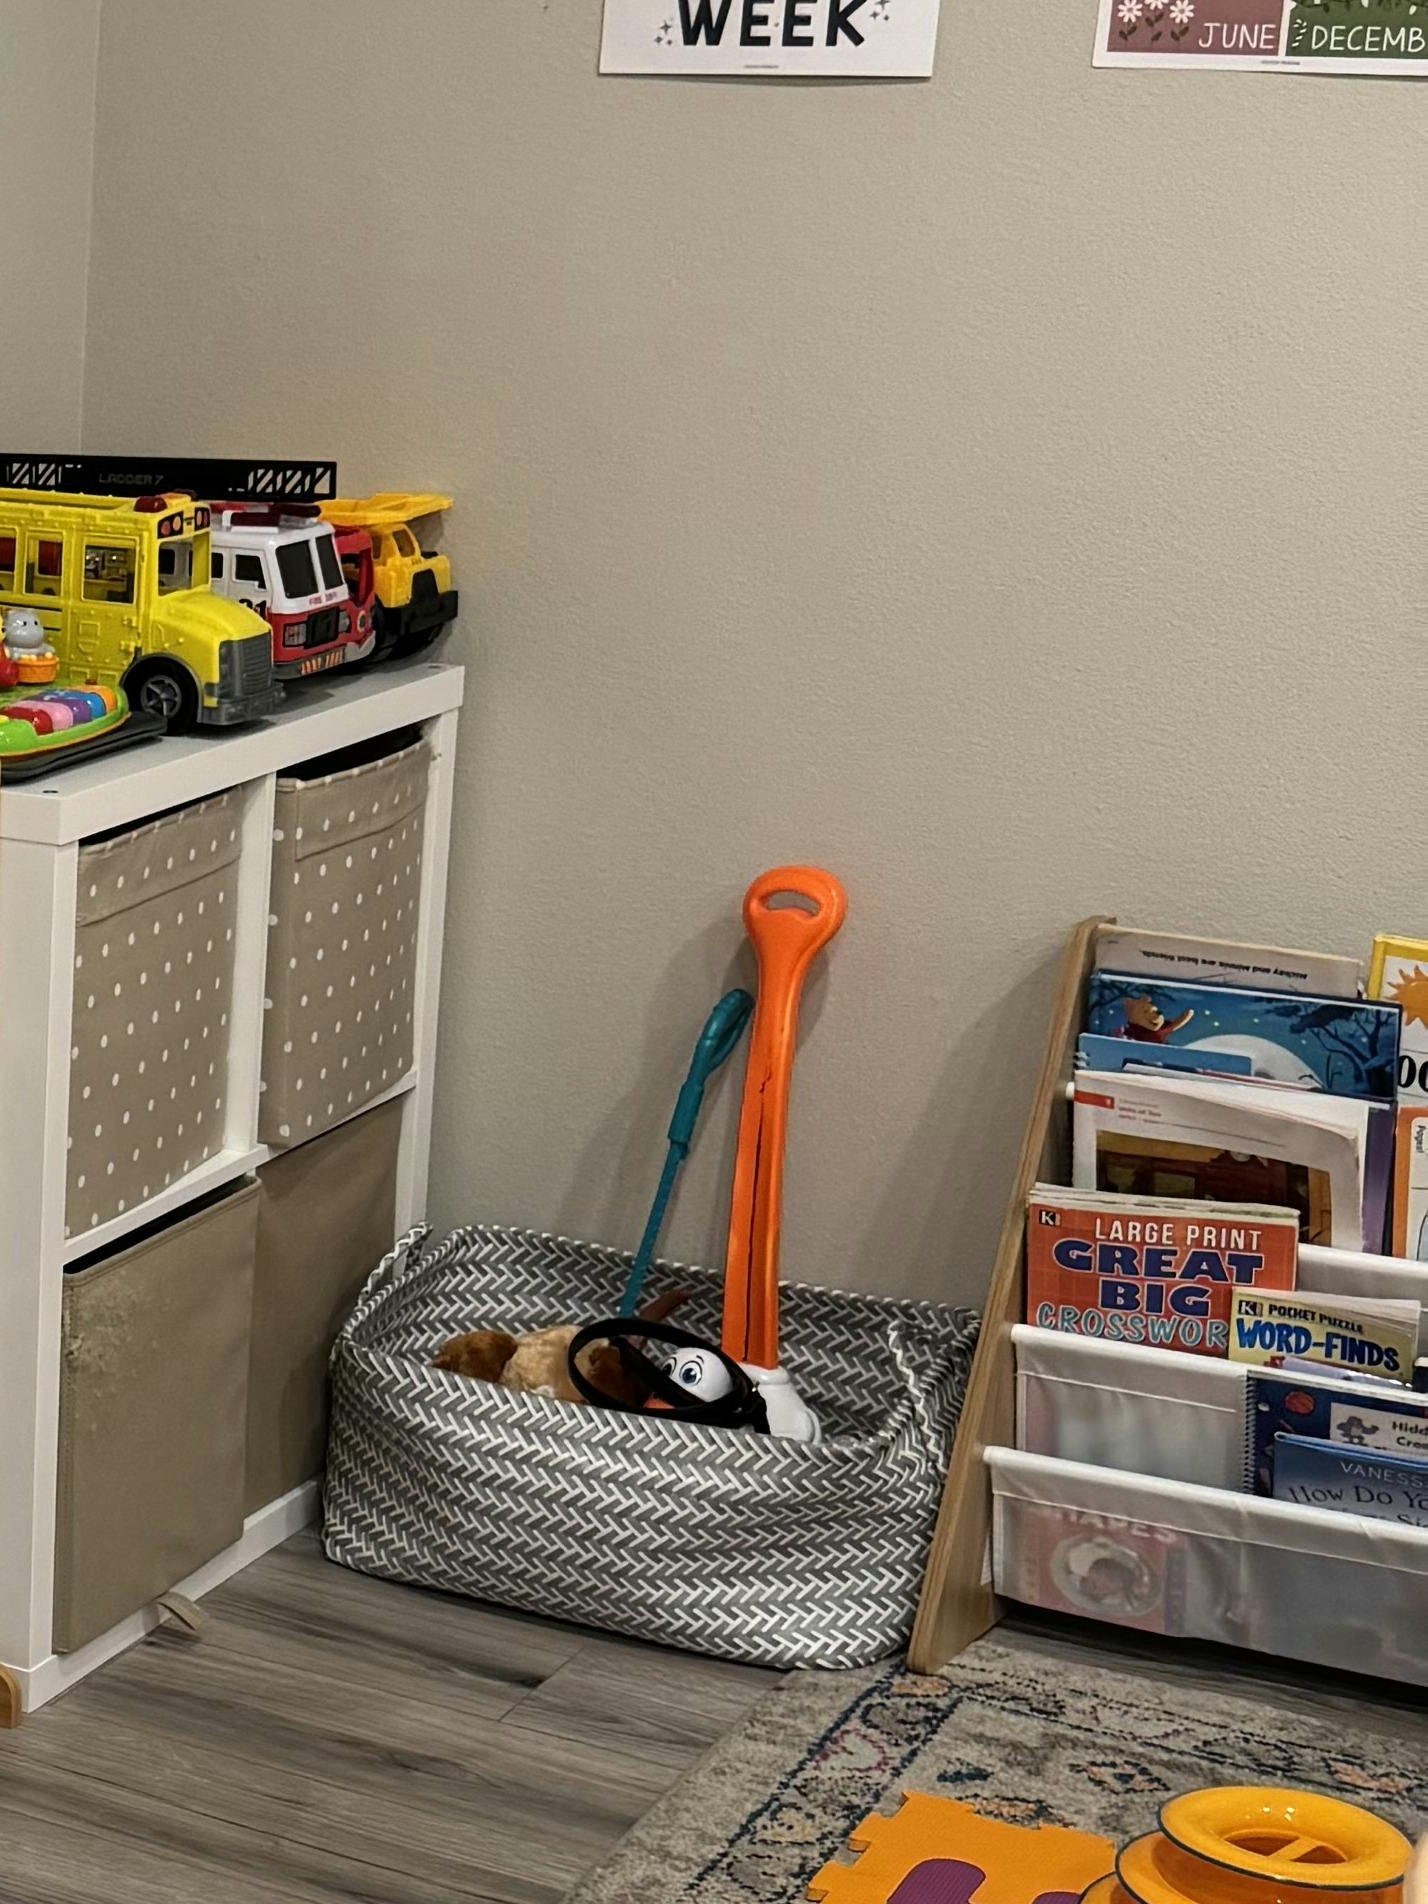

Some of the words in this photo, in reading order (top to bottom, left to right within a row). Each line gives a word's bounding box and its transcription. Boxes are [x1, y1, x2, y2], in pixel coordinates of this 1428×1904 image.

[1198, 23, 1276, 49] JUNE
[99, 473, 153, 485] LADDER
[1095, 1218, 1174, 1245] LARGE
[1186, 1225, 1261, 1250] PRINT
[1053, 1238, 1264, 1286] GREAT
[1099, 1277, 1212, 1318] BIG
[1269, 1304, 1316, 1321] POCKET
[1319, 1314, 1364, 1334] PUZZLE
[1237, 1318, 1400, 1372] WORD-FINDS
